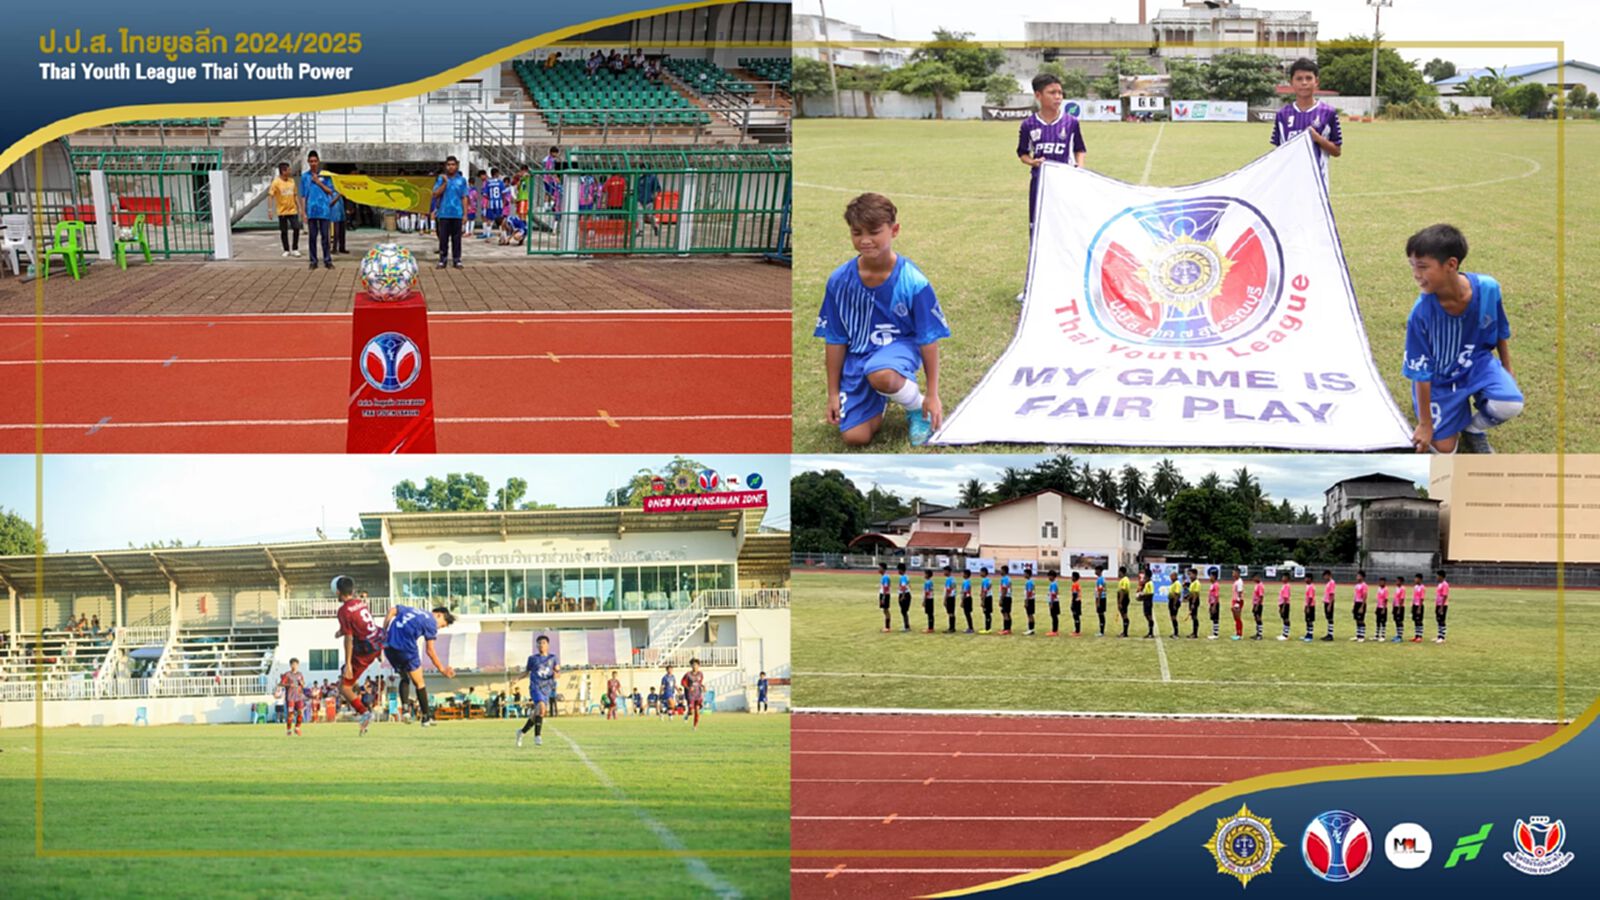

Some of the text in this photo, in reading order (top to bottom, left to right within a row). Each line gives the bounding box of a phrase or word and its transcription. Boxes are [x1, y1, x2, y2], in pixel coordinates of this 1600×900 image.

[1035, 143, 1066, 154] PSC
[489, 186, 500, 198] 18
[1055, 274, 1309, 361] Thai Youth League
[1010, 367, 1356, 391] MY GAME IS
[1014, 395, 1333, 423] FAIR PLAY
[360, 608, 377, 632] 9
